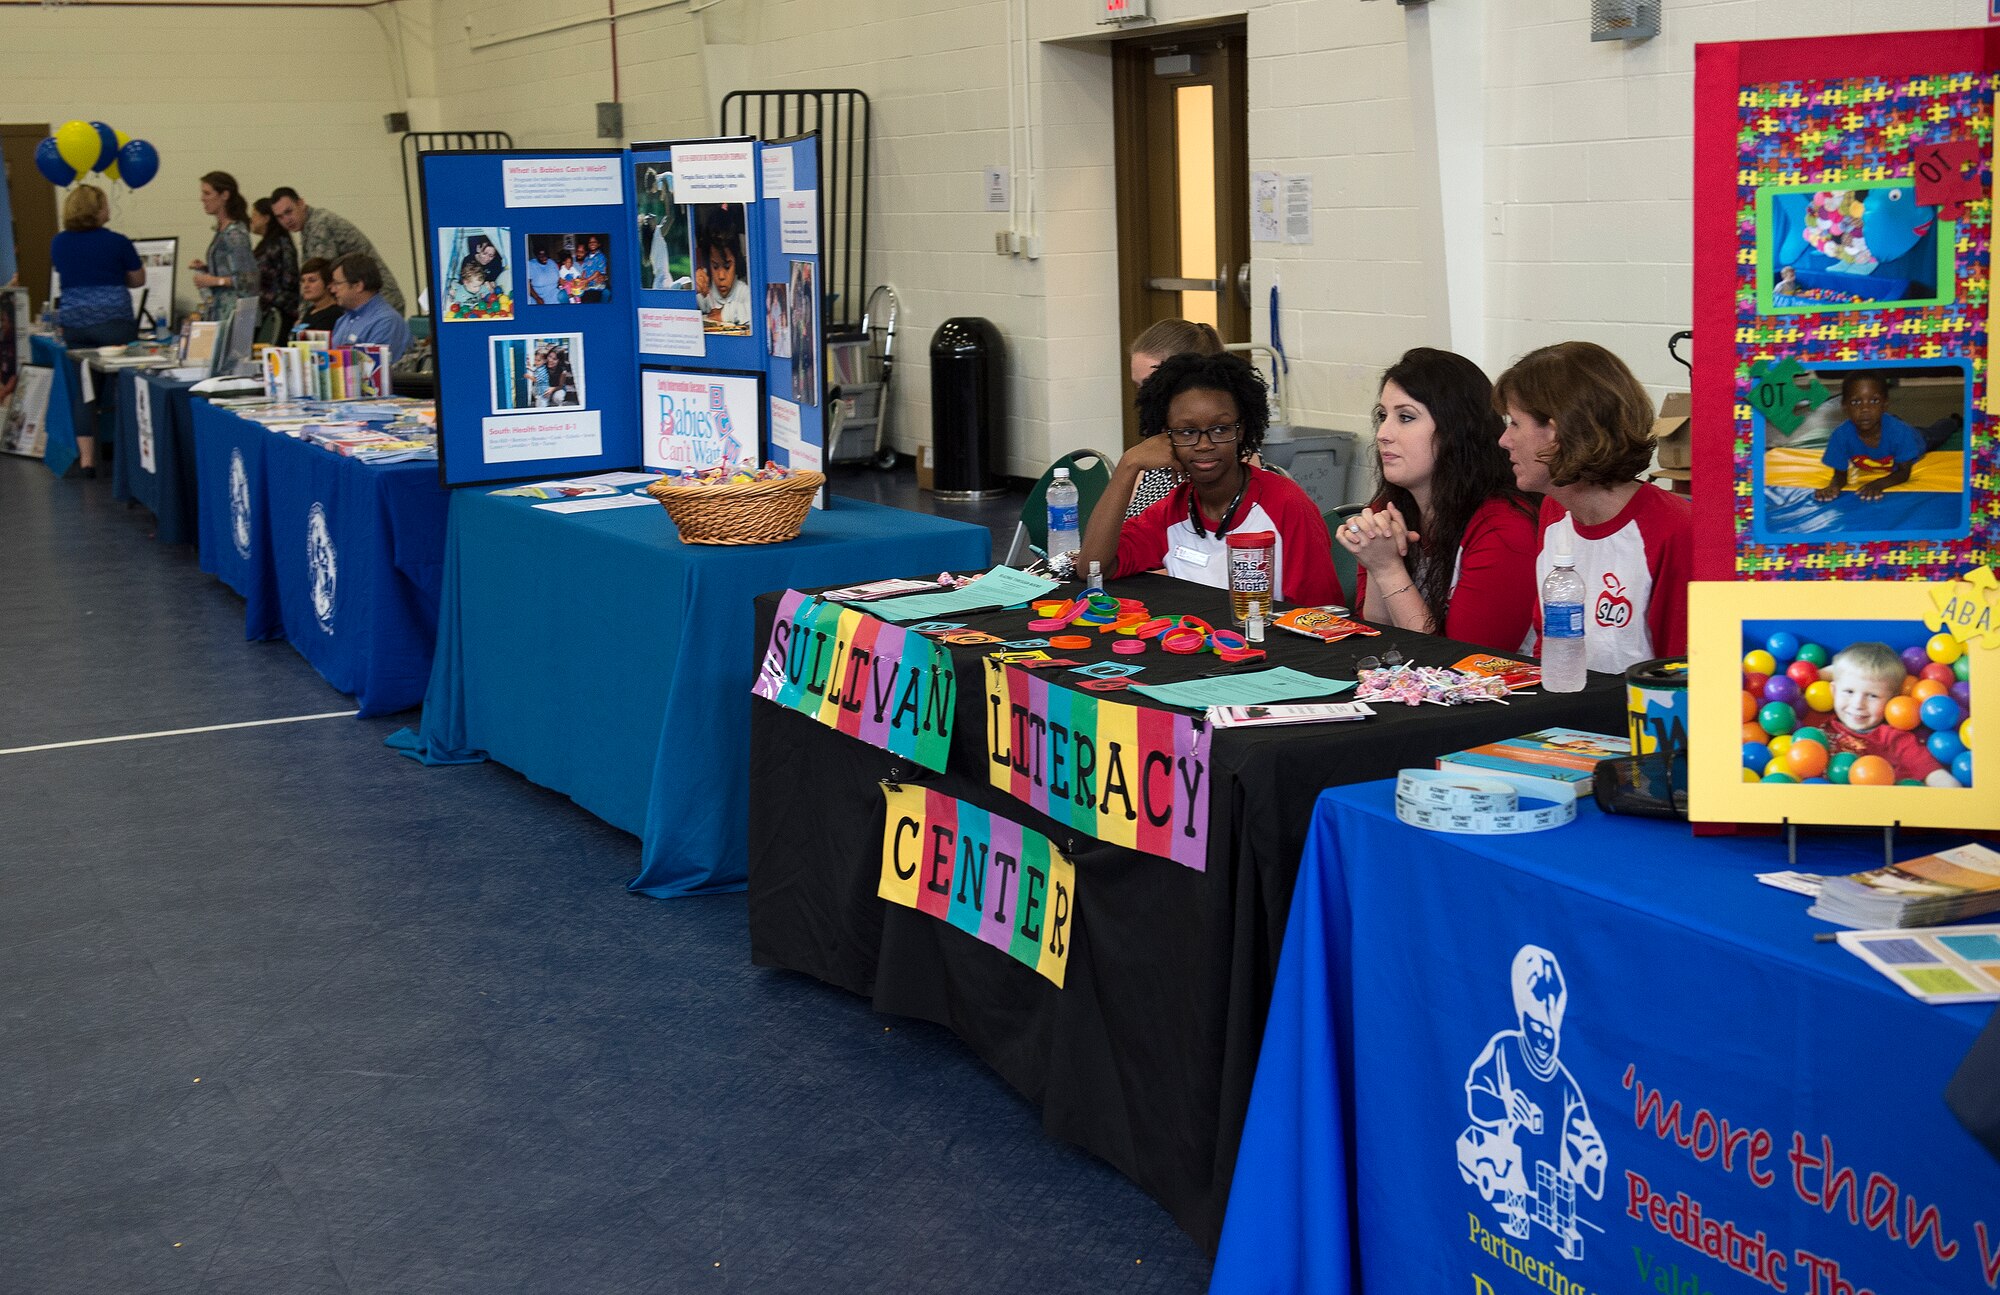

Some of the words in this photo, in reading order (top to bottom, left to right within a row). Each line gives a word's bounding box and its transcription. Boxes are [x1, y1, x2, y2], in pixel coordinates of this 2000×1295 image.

[508, 166, 529, 174] What
[540, 166, 564, 174] Babies
[1919, 150, 1952, 184] OT
[1760, 382, 1785, 408] OT
[489, 427, 511, 436] South
[512, 425, 536, 434] Health
[538, 424, 563, 432] District
[658, 394, 712, 438] Babies
[658, 437, 691, 463] Can't
[1233, 561, 1257, 571] MRS
[1234, 581, 1268, 592] RIGHT
[1597, 602, 1625, 624] SLC
[1941, 596, 1990, 632] ABA
[769, 619, 953, 738] SULLIVAN
[990, 694, 1205, 838] LITERACY
[893, 816, 1069, 958] CENTER
[1622, 1063, 1775, 1188] 'more
[1788, 1130, 1959, 1261] than
[1625, 1169, 1787, 1293] Pediatric
[1795, 1249, 1877, 1295] Th
